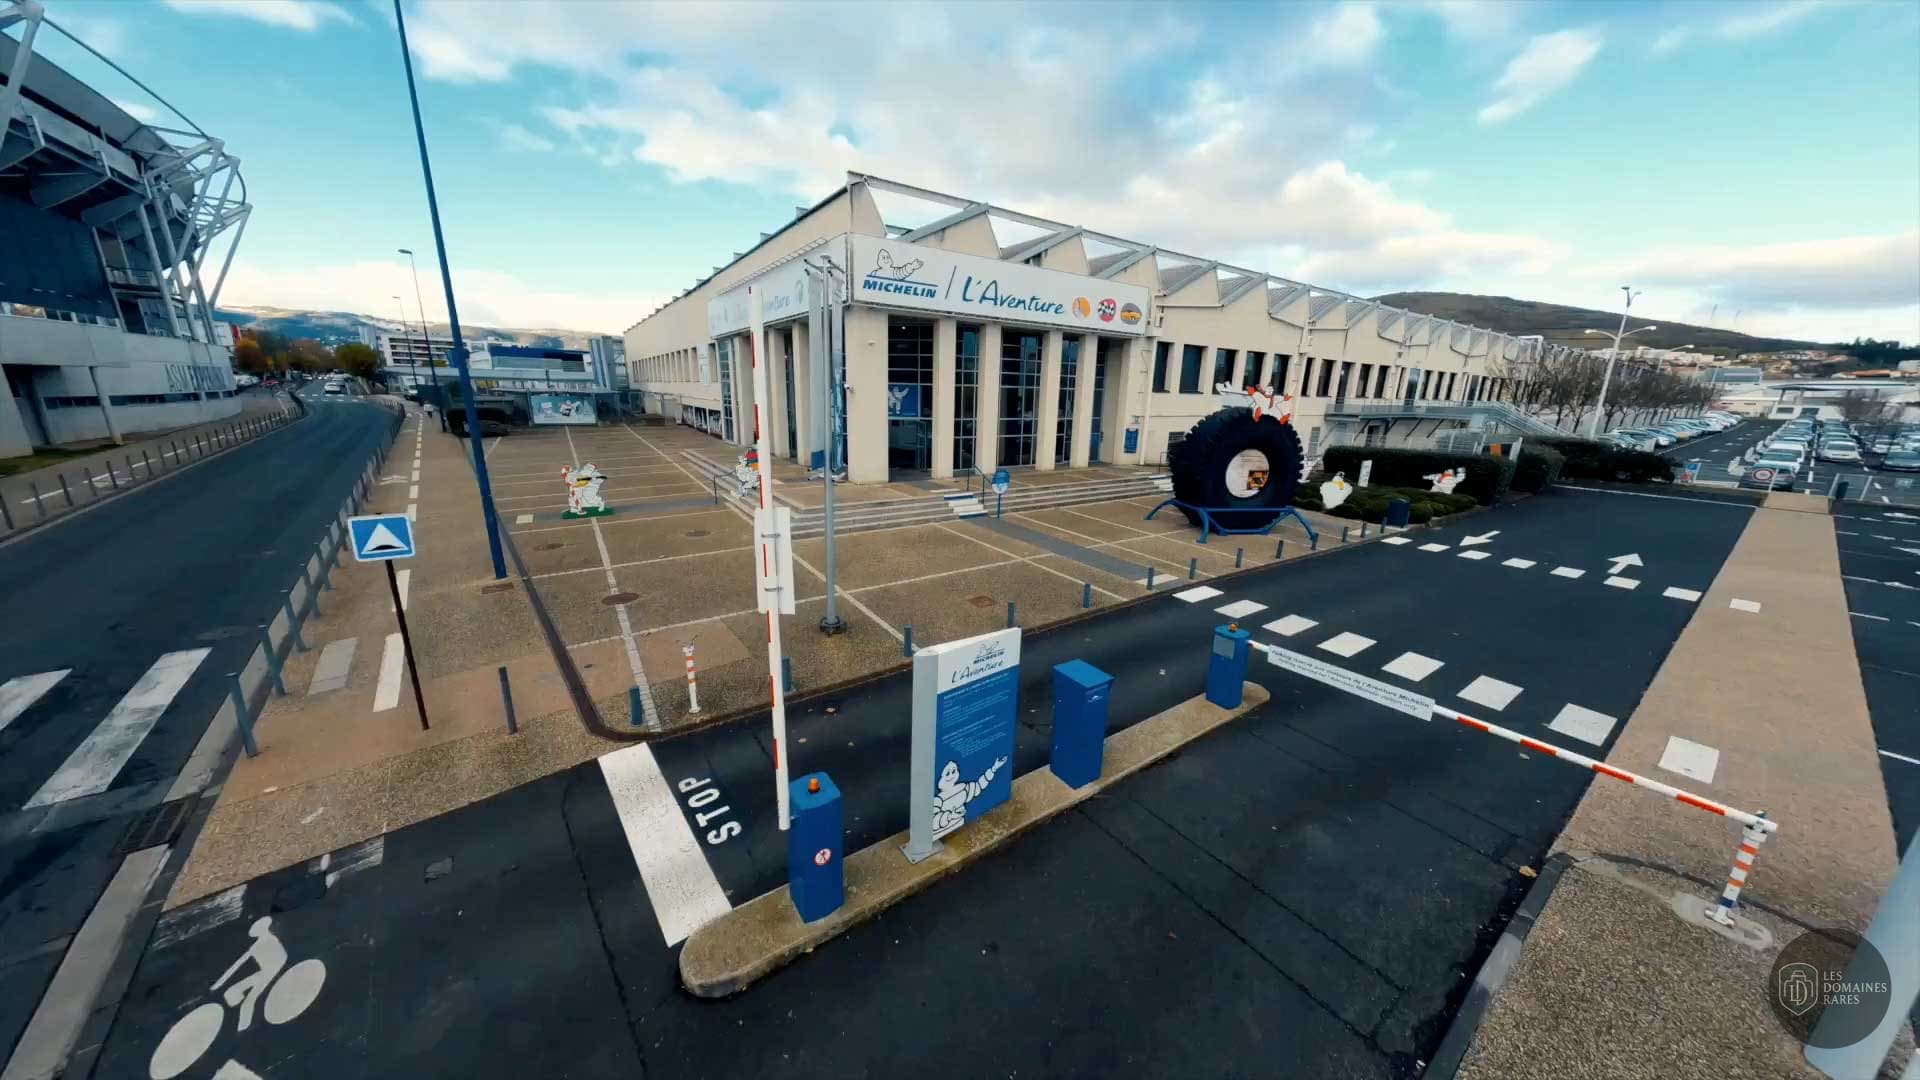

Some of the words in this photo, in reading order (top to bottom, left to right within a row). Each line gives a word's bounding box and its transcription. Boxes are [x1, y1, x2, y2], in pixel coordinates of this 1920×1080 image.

[863, 279, 937, 298] MICHELIN
[962, 275, 1065, 315] L'Aventure
[951, 659, 1004, 684] L'Aventure
[678, 777, 742, 845] STOP
